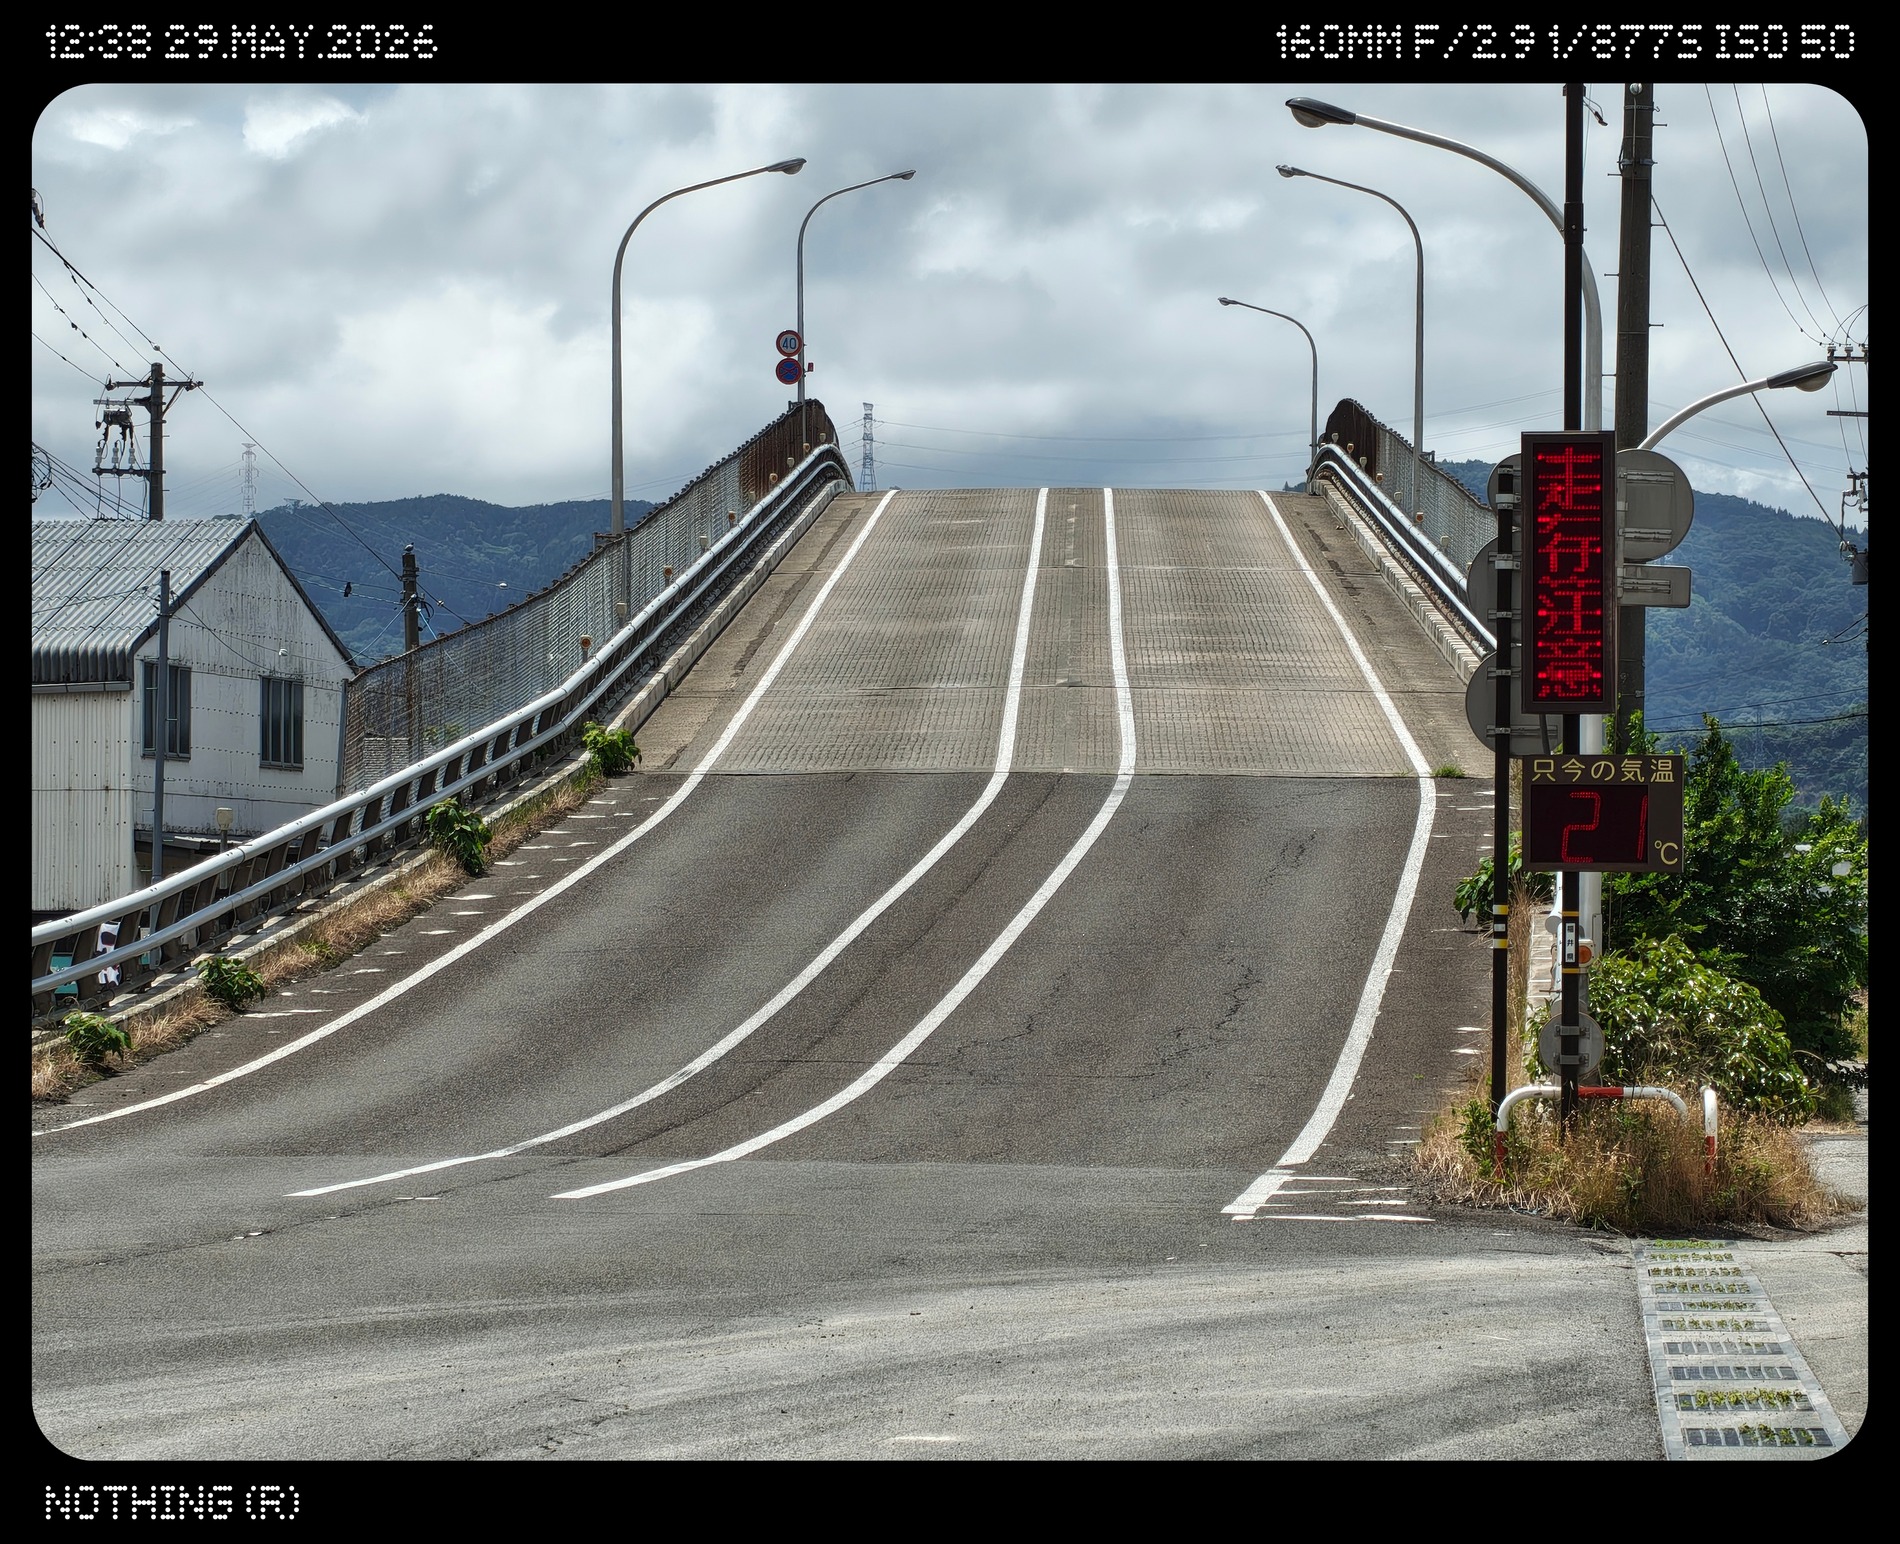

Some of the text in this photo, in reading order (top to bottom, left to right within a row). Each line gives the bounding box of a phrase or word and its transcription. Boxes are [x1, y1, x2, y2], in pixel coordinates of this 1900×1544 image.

[782, 337, 797, 350] 40
[1537, 447, 1601, 698] 走行注意
[1531, 758, 1675, 783] 只今の気温
[1562, 791, 1648, 863] 21
